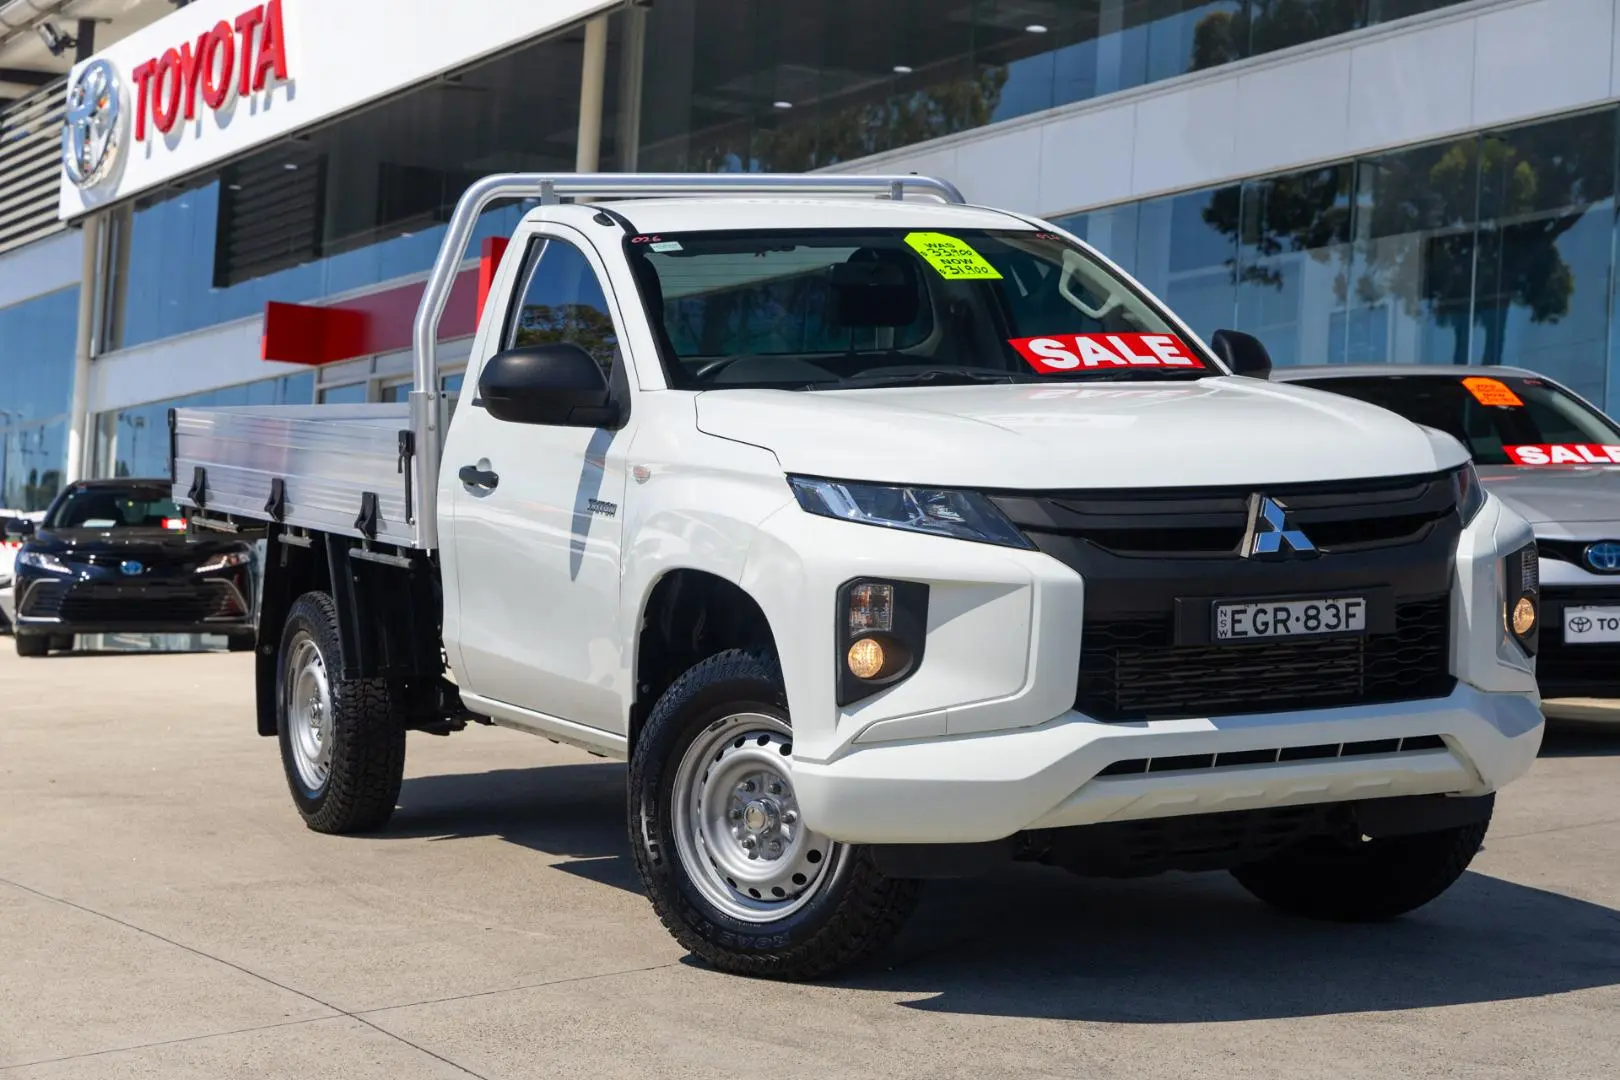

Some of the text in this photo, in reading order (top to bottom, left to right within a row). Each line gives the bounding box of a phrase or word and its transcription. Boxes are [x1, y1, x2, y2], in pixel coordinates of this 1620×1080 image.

[132, 0, 288, 142] TOYOTA
[1028, 335, 1193, 369] SALE
[1597, 617, 1620, 631] TO
